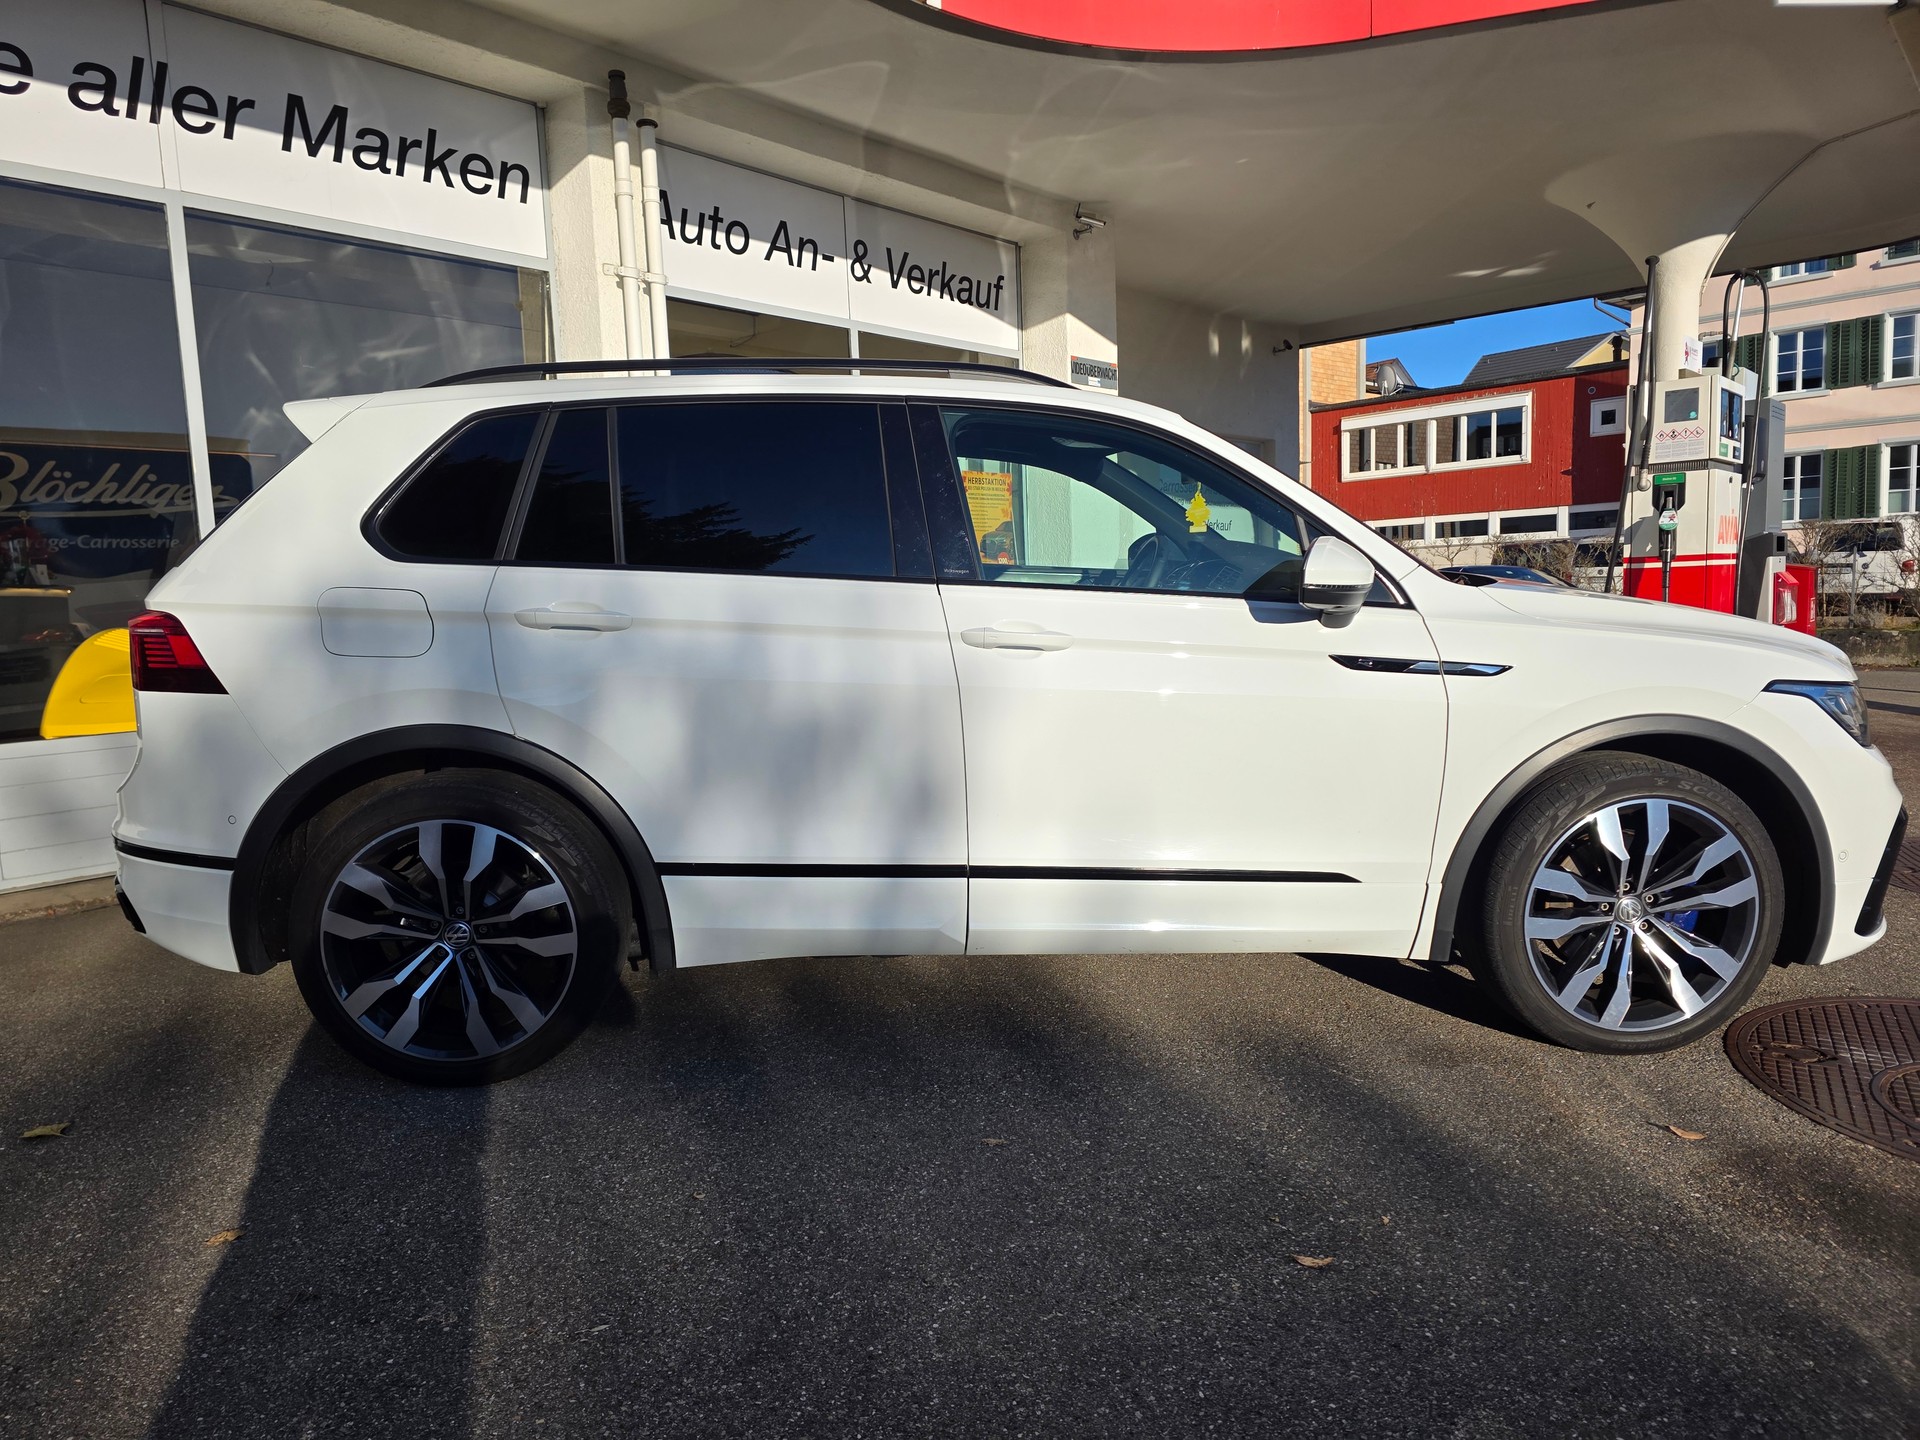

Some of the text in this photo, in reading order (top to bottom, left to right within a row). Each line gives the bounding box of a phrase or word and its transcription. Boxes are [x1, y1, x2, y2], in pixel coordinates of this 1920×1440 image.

[67, 55, 256, 141] aller
[281, 93, 532, 205] Marken
[658, 188, 1005, 312] Auto An- & Verkauf
[967, 476, 1007, 487] HERBSTAKTION
[1717, 510, 1739, 545] AVIA
